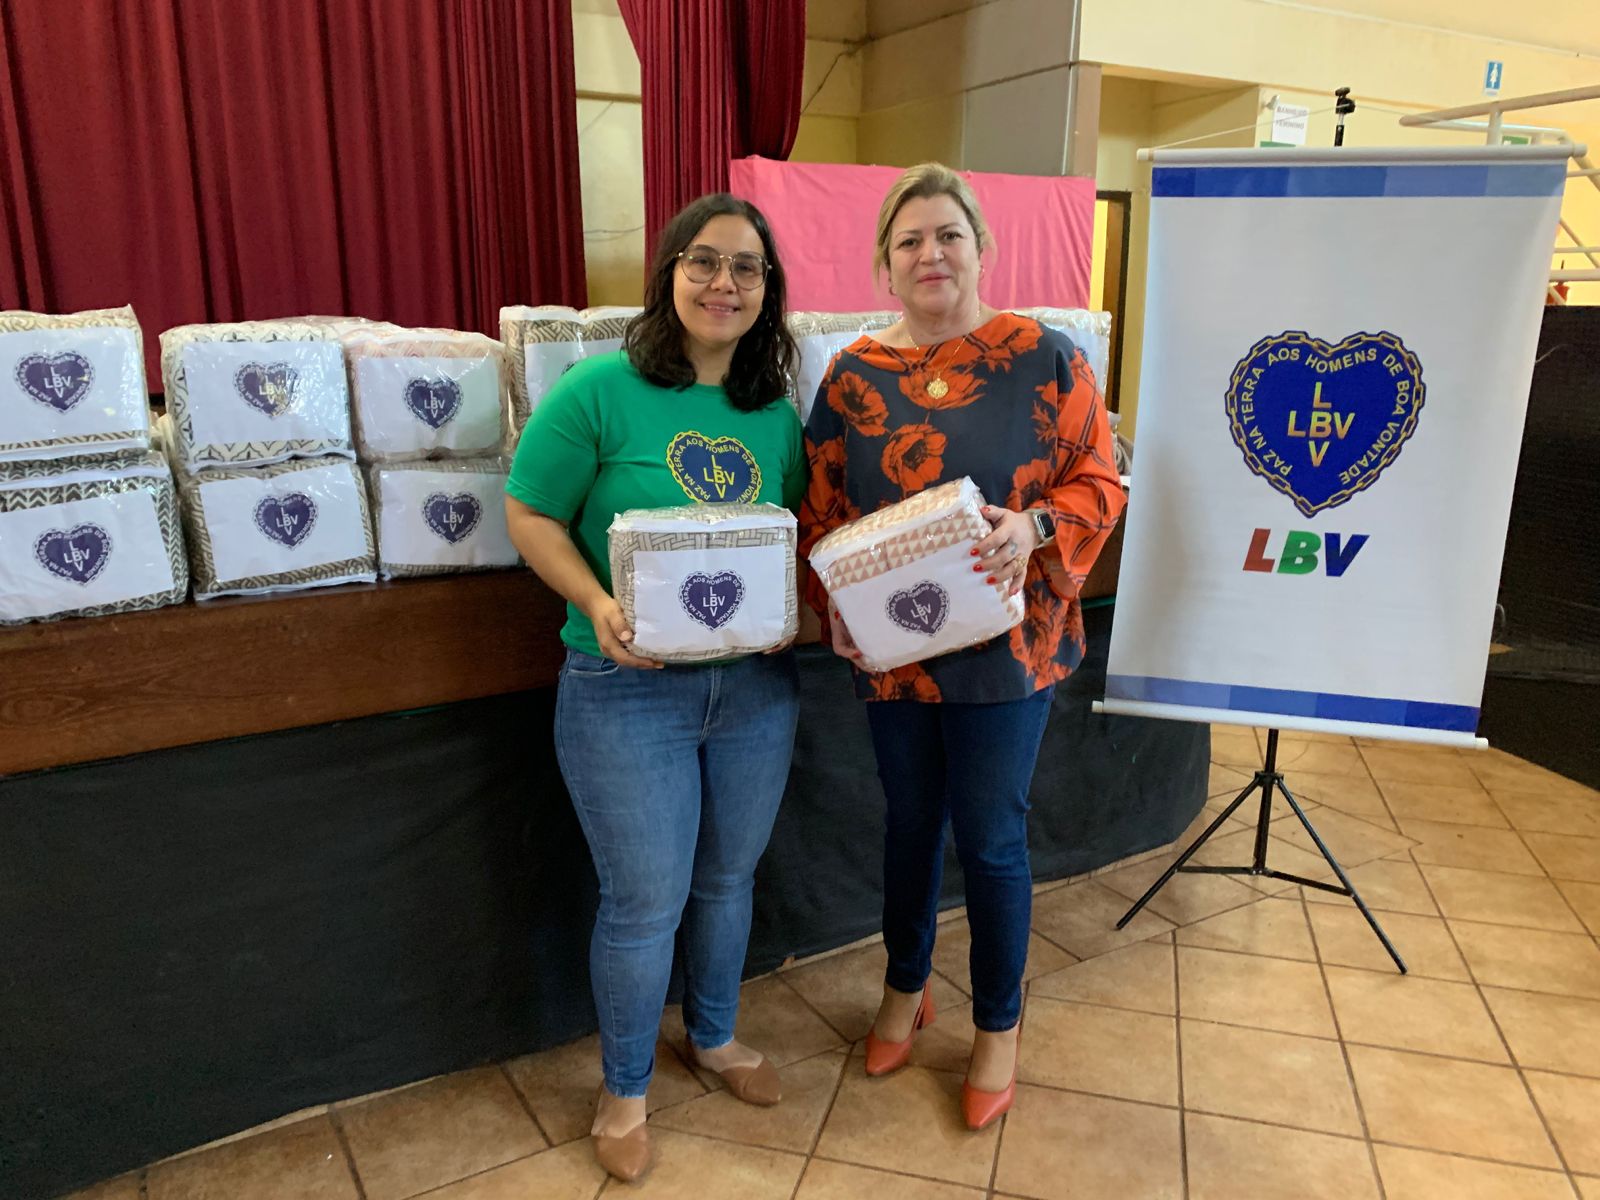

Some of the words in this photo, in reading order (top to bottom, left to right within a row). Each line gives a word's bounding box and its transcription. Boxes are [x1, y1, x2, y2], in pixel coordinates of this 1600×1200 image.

[1267, 348, 1300, 366] AOS
[1305, 348, 1377, 373] HOMENS
[1382, 354, 1403, 377] DE
[44, 376, 71, 388] LBV
[424, 400, 445, 409] LBV
[1241, 367, 1265, 424] TERRA
[1313, 382, 1332, 409] L
[1392, 380, 1410, 416] BOA
[1288, 410, 1355, 440] LBV
[686, 438, 704, 447] AOS
[1250, 425, 1266, 450] NA
[705, 445, 740, 454] HOMENS
[1309, 440, 1329, 467] V
[1339, 421, 1400, 485] VONTADE
[674, 445, 686, 473] TERRA
[1263, 449, 1293, 476] PAZ
[684, 473, 695, 486] NA
[704, 468, 735, 485] LBV
[695, 485, 710, 500] PAZ
[276, 515, 298, 527] LBV
[443, 514, 464, 523] LBV
[64, 549, 89, 563] LBV
[1242, 528, 1370, 577] LBV
[703, 596, 725, 607] LBV
[911, 603, 931, 618] LBV
